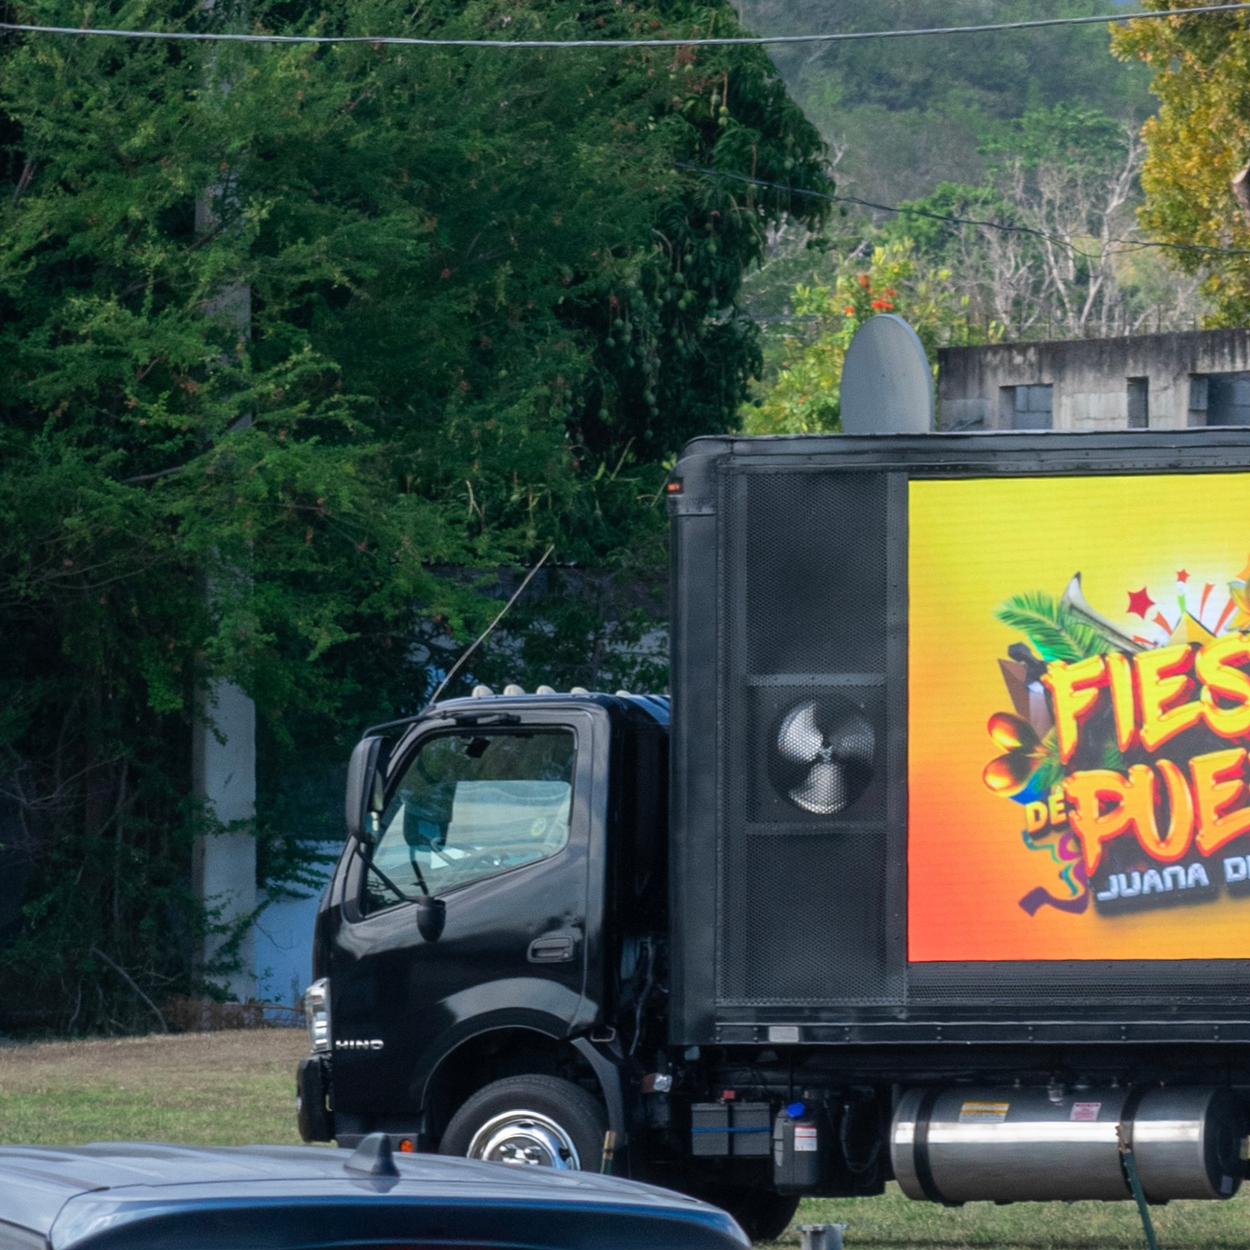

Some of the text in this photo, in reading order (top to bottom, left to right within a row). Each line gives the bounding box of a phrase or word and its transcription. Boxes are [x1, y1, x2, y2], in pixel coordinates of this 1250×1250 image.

[1025, 790, 1067, 833] DE
[1096, 861, 1210, 901] JUANA
[335, 1039, 384, 1050] HINO
